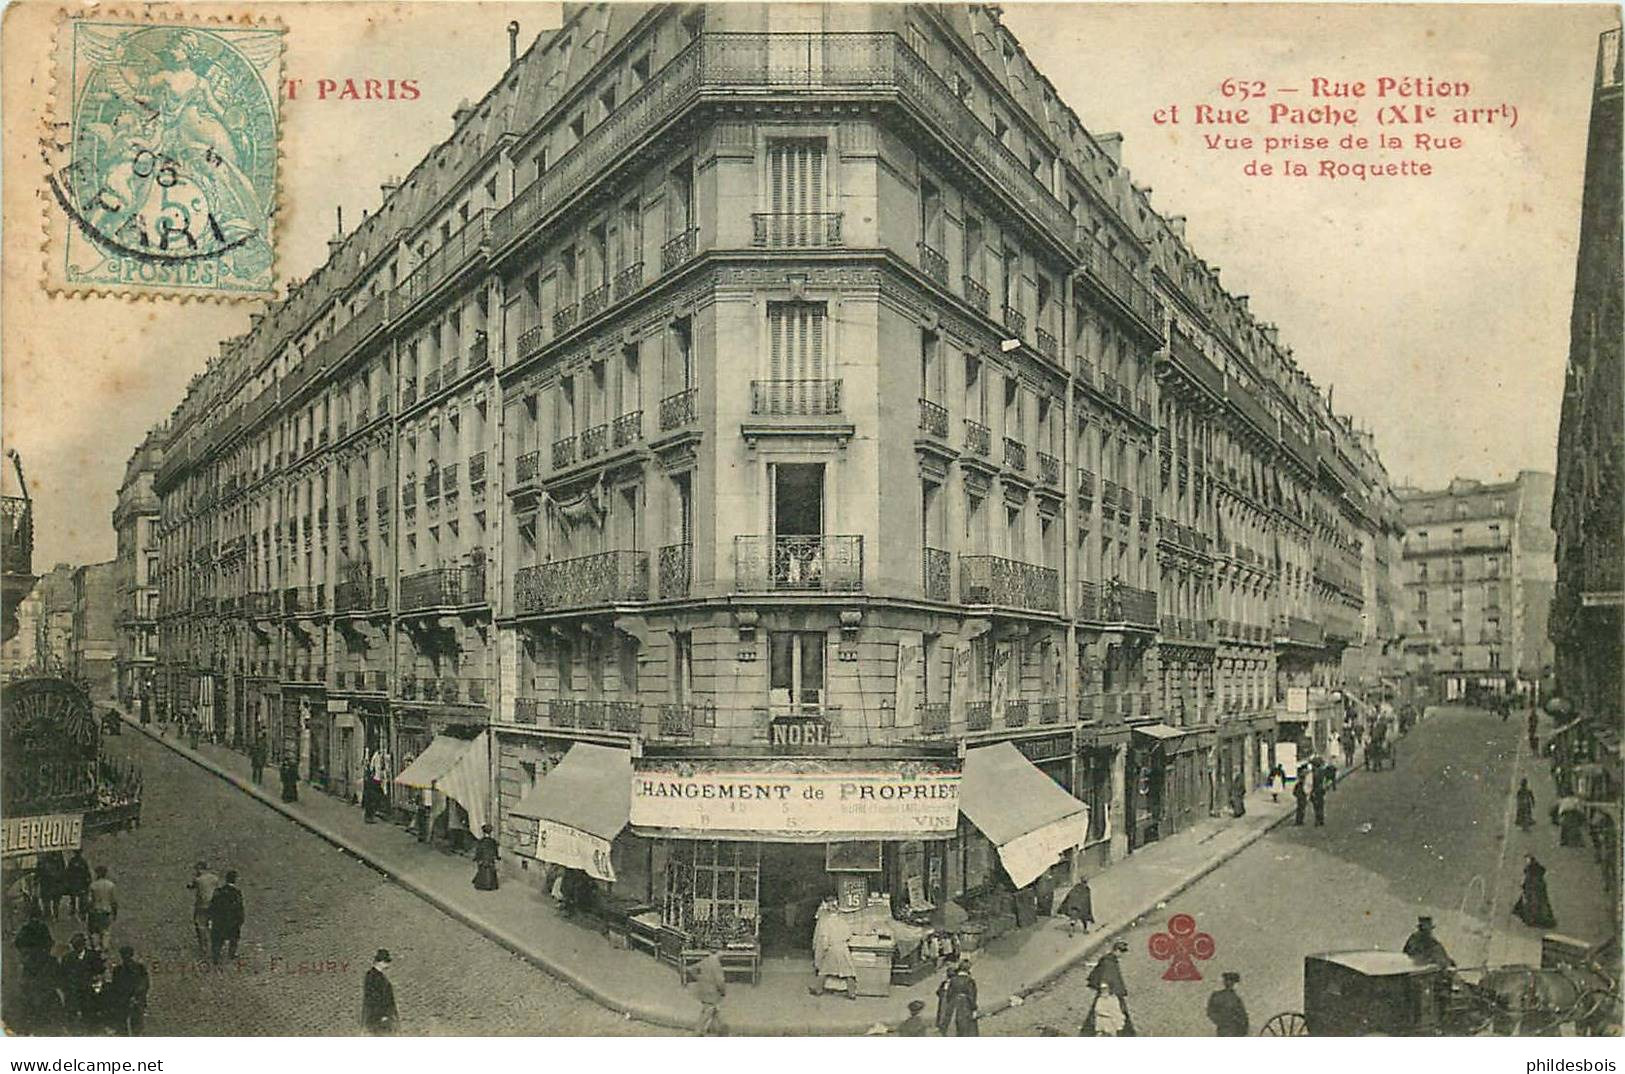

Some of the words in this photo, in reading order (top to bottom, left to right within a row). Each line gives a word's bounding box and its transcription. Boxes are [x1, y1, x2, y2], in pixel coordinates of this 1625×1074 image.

[123, 258, 214, 284] POSTES
[773, 723, 830, 745] NOËL
[802, 786, 824, 800] de
